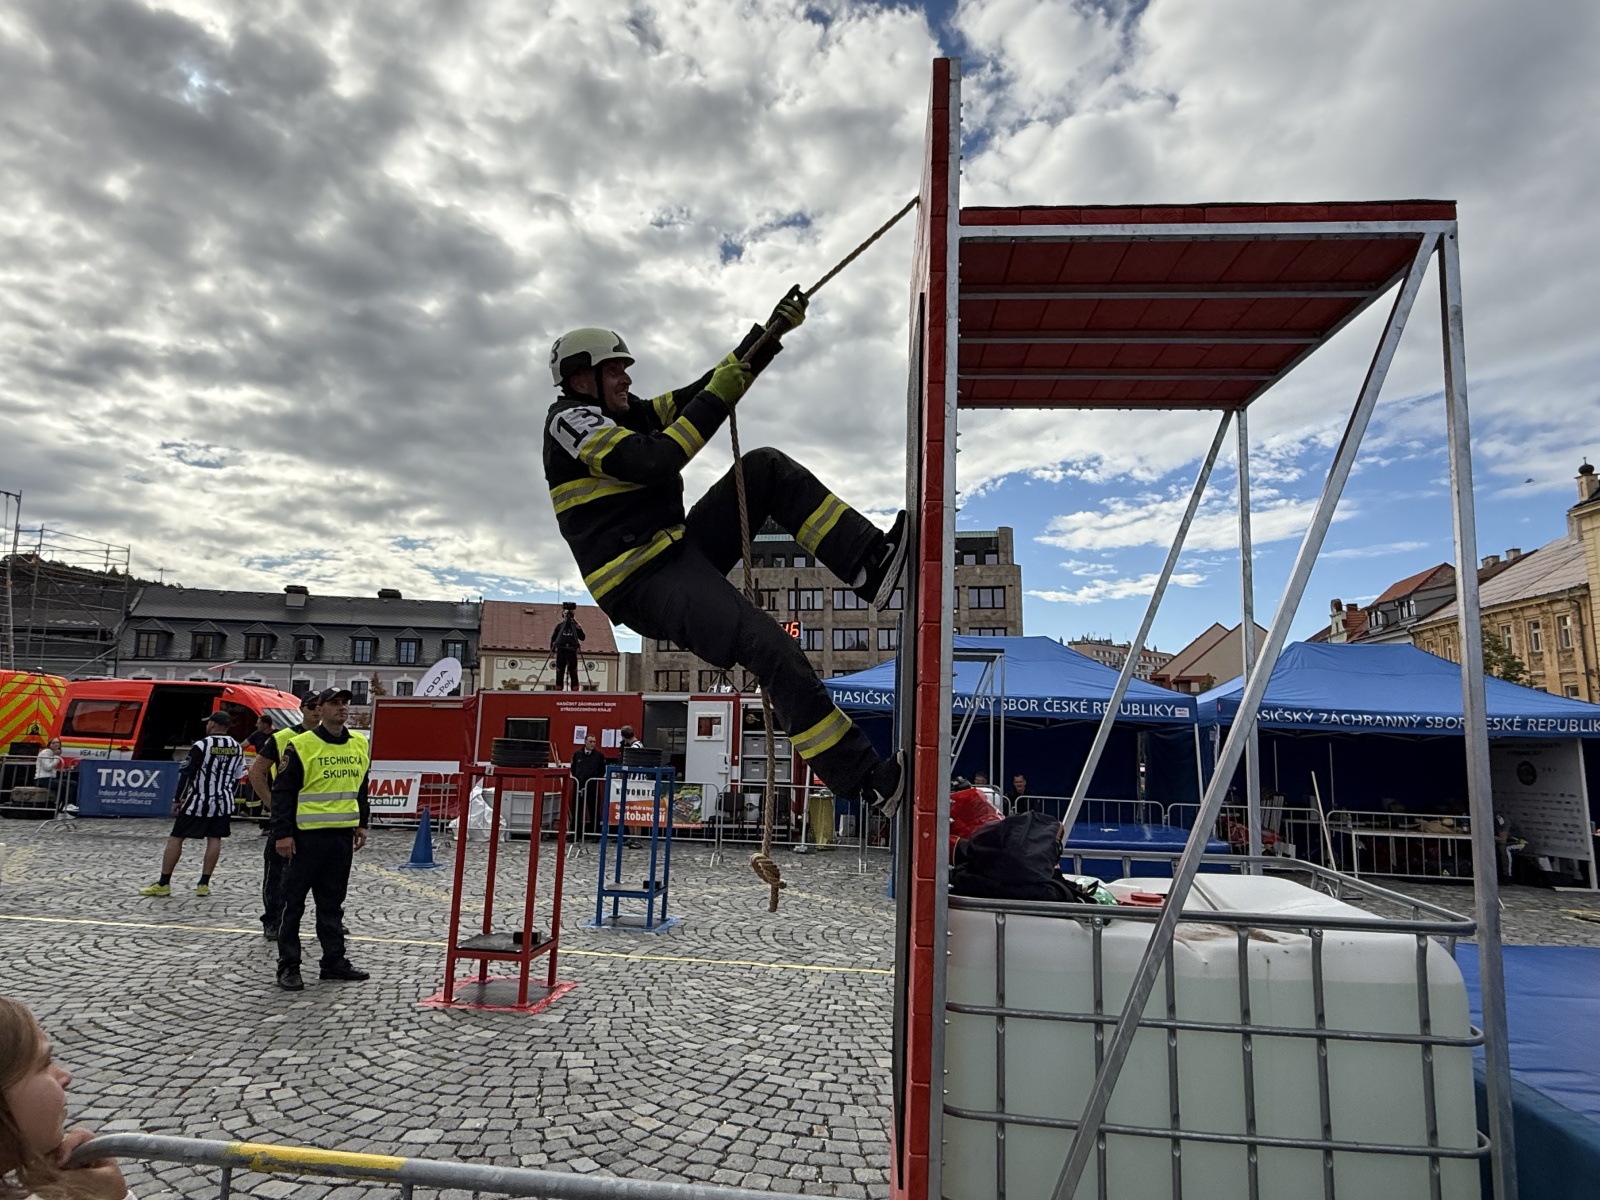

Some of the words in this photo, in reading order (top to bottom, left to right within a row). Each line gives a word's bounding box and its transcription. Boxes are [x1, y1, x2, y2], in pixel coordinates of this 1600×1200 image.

[557, 408, 604, 449] 13
[424, 670, 448, 697] KODA
[436, 677, 454, 697] -Poly
[833, 690, 895, 705] HASIČSK
[1043, 697, 1088, 713] ČESKÉ
[1093, 701, 1175, 716] REUBLIKY
[1257, 708, 1314, 723] SIČSKÝ
[1318, 711, 1420, 728] ZÁCHRANNÝ
[1486, 716, 1522, 731] ESKÉ
[1527, 718, 1600, 732] REPUBLIK
[97, 768, 160, 788] TROX
[323, 769, 360, 779] SKUPINA
[128, 790, 156, 798] Solutions
[368, 778, 413, 796] MAN
[615, 811, 665, 822] atobateií
